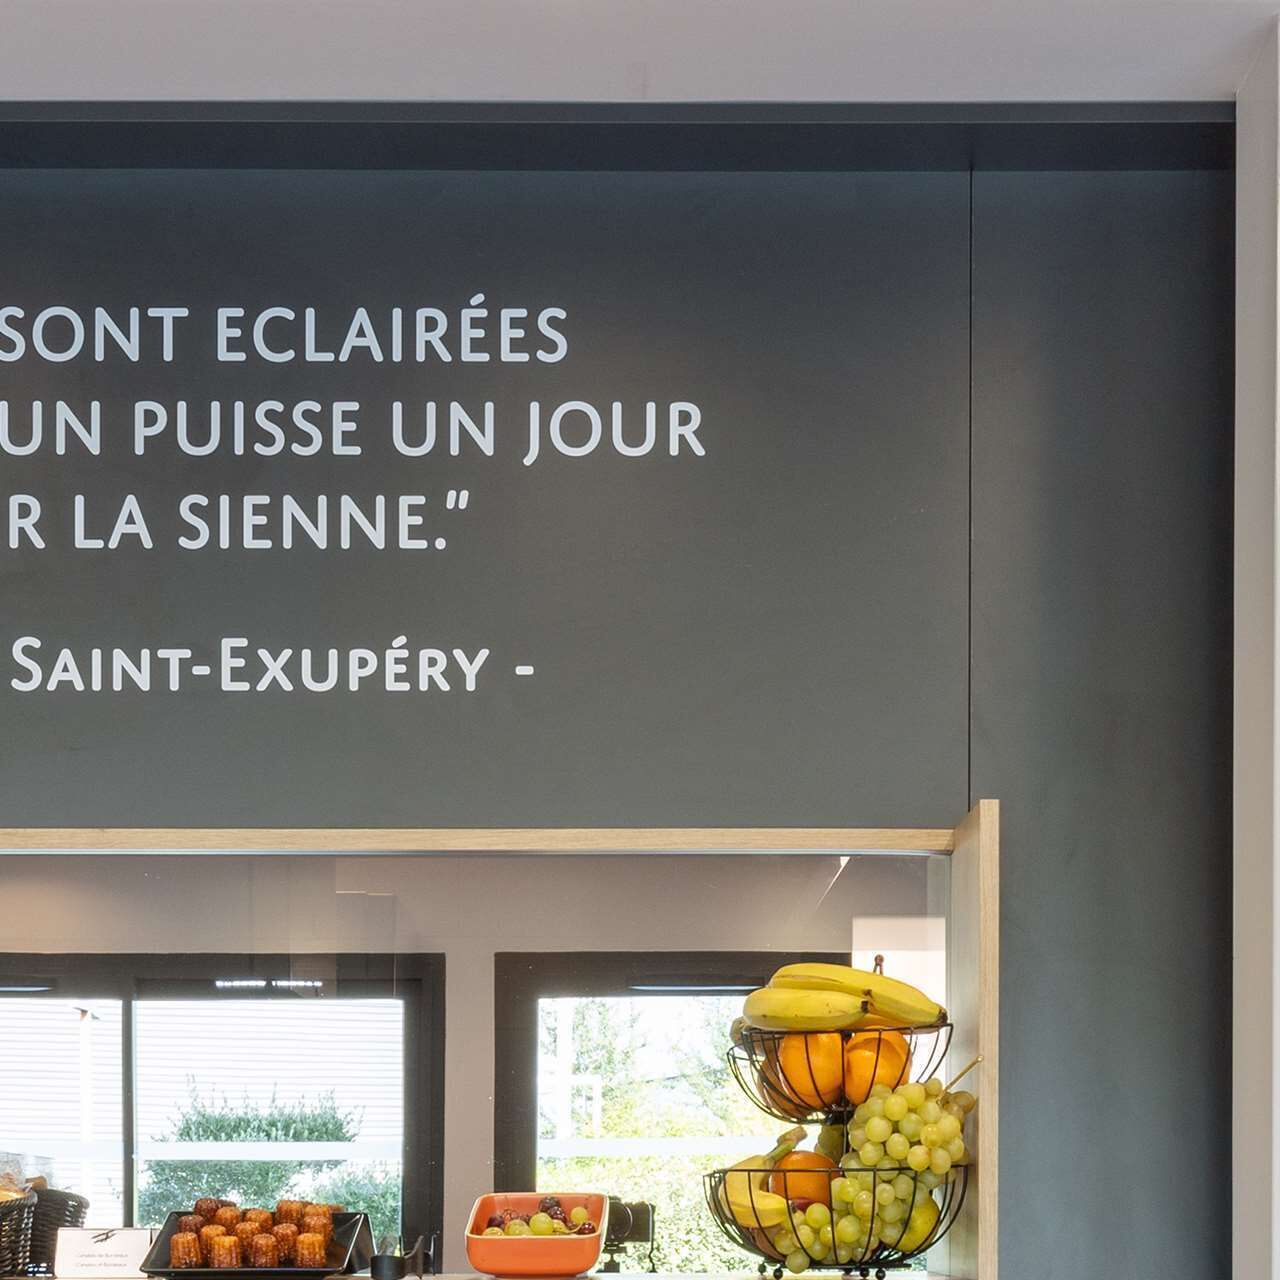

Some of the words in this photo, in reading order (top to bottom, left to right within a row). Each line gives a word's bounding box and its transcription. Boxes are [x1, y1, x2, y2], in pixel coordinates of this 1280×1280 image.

[216, 293, 568, 363] ECLAIRÉES
[133, 400, 363, 457] PUISSE
[391, 401, 496, 457] UN
[522, 400, 707, 467] JOUR
[73, 494, 155, 550] LA
